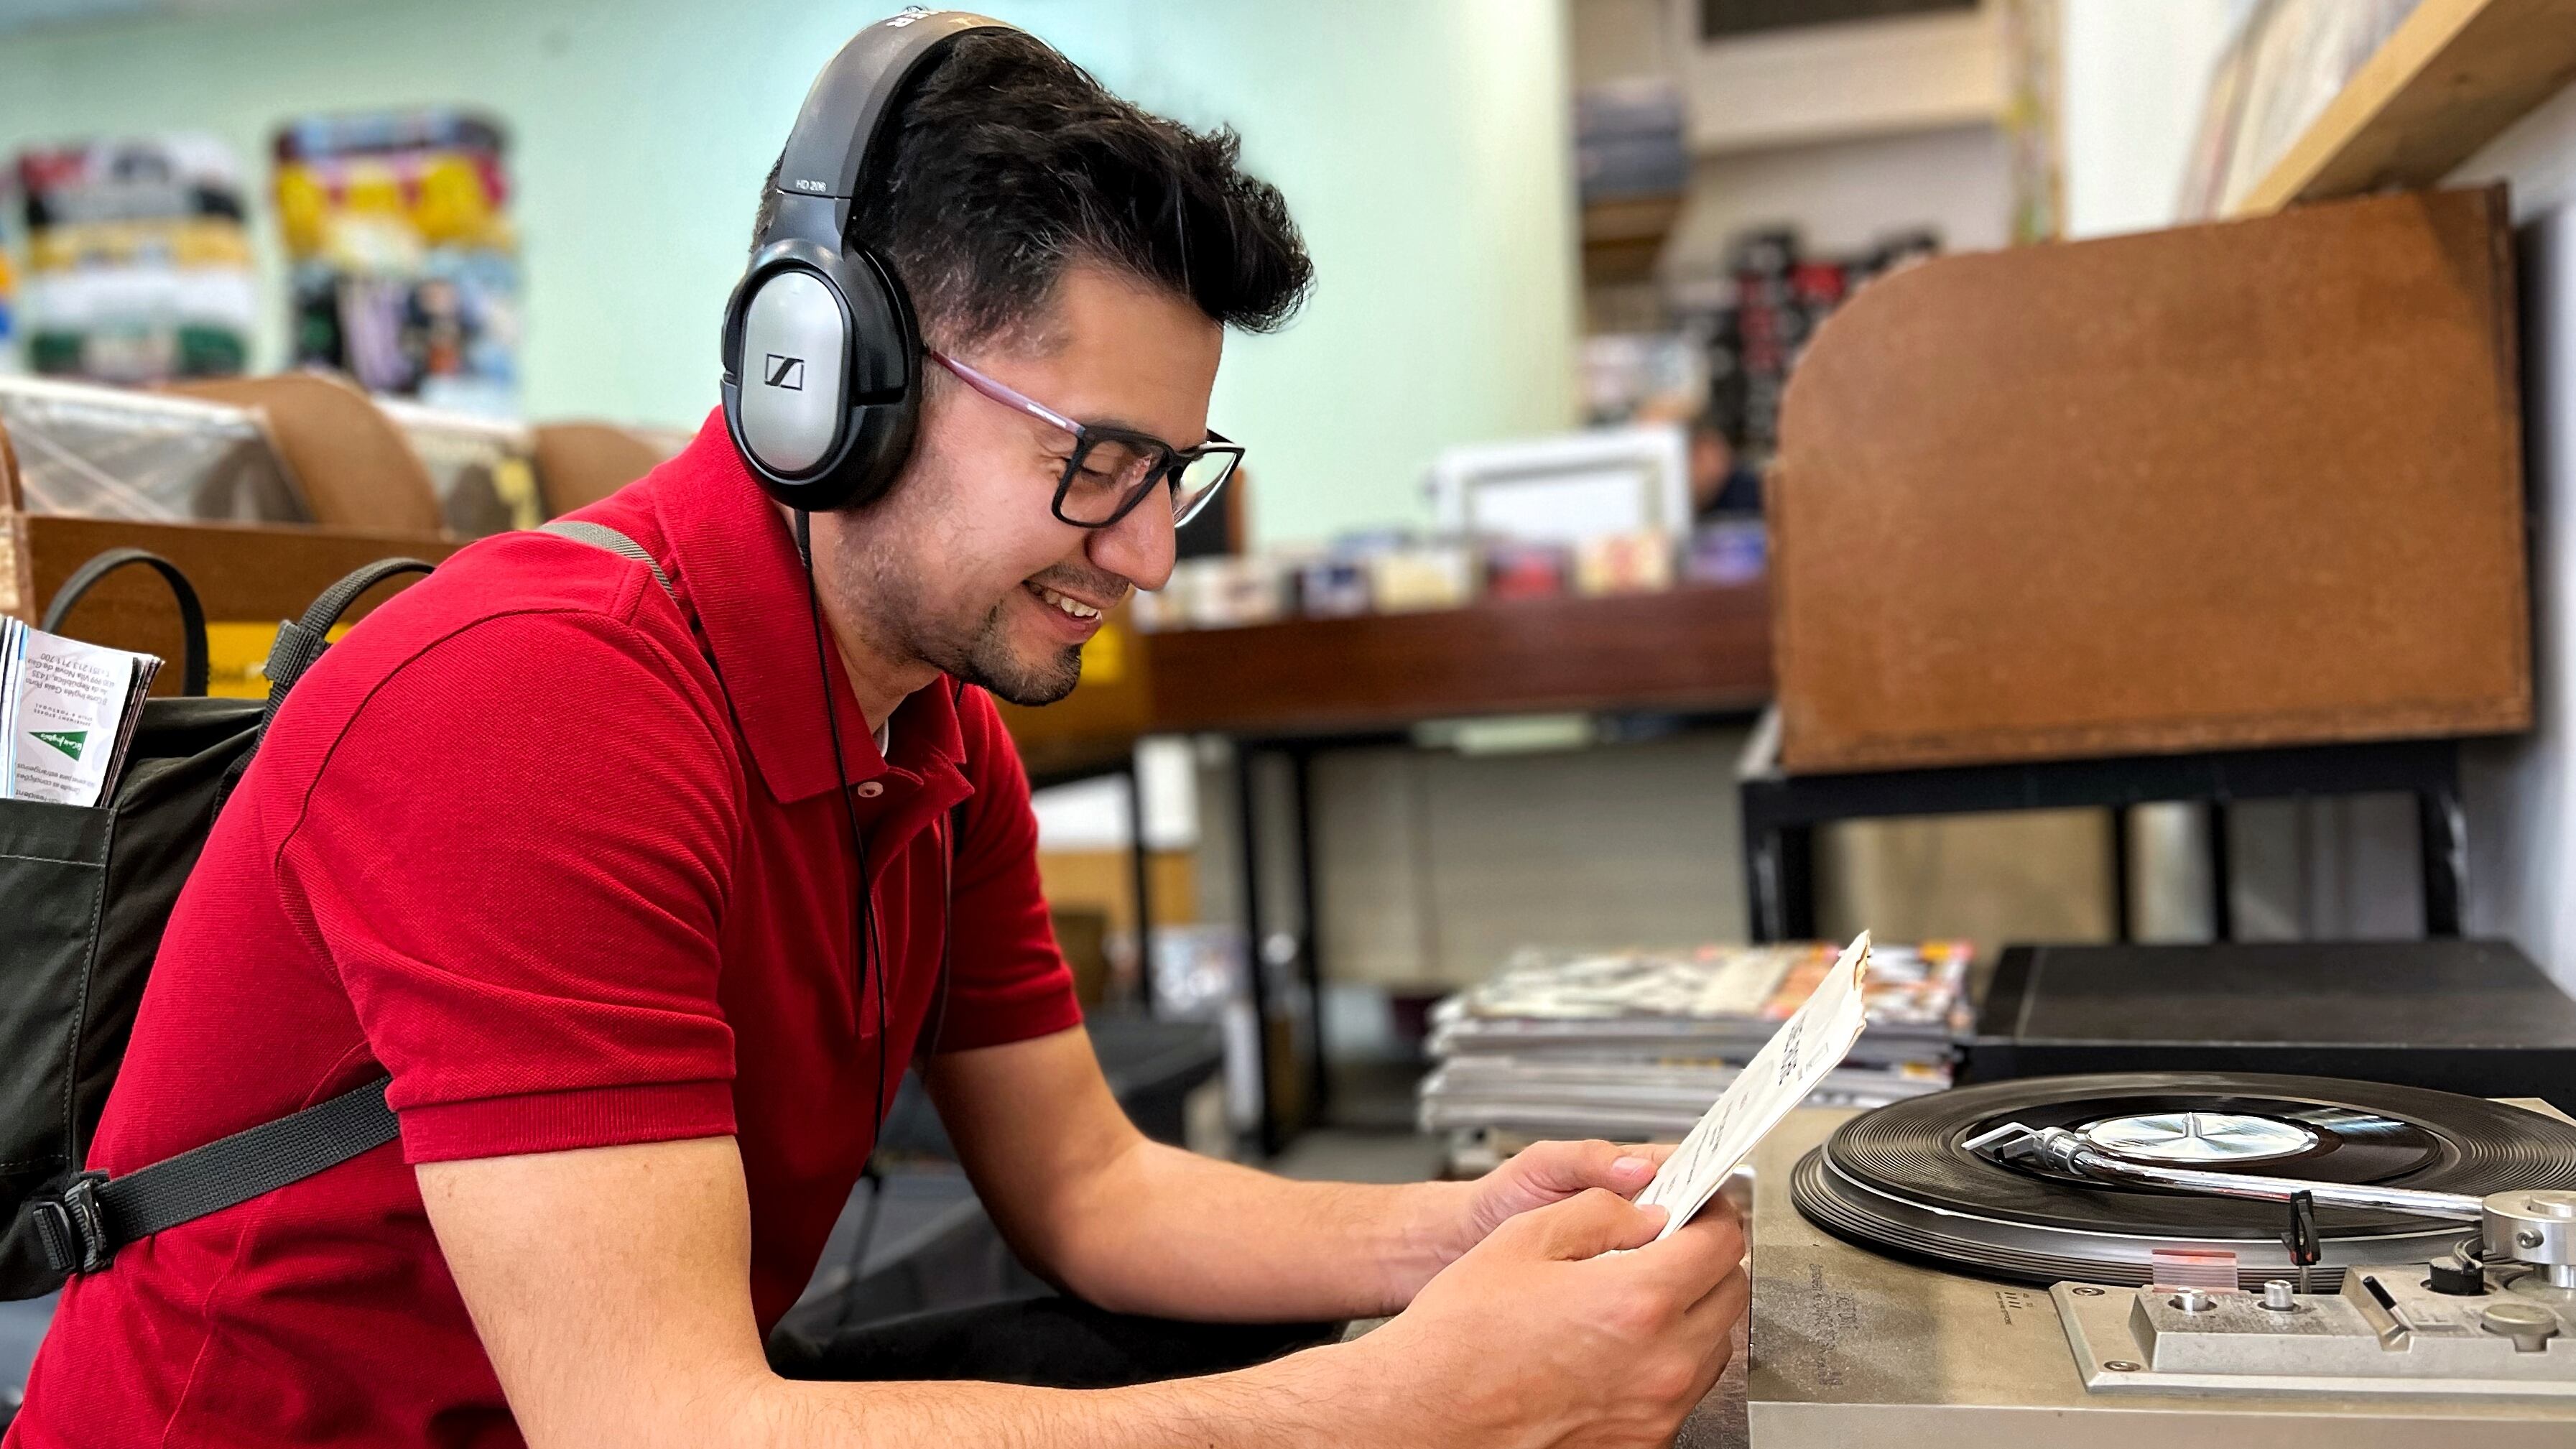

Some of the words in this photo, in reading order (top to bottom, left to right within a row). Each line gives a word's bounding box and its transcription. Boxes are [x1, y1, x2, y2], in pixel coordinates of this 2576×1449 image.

[796, 180, 810, 190] HD
[41, 653, 55, 663] 700
[43, 663, 53, 672] de
[55, 667, 75, 678] Nova
[45, 683, 62, 694] Gaia
